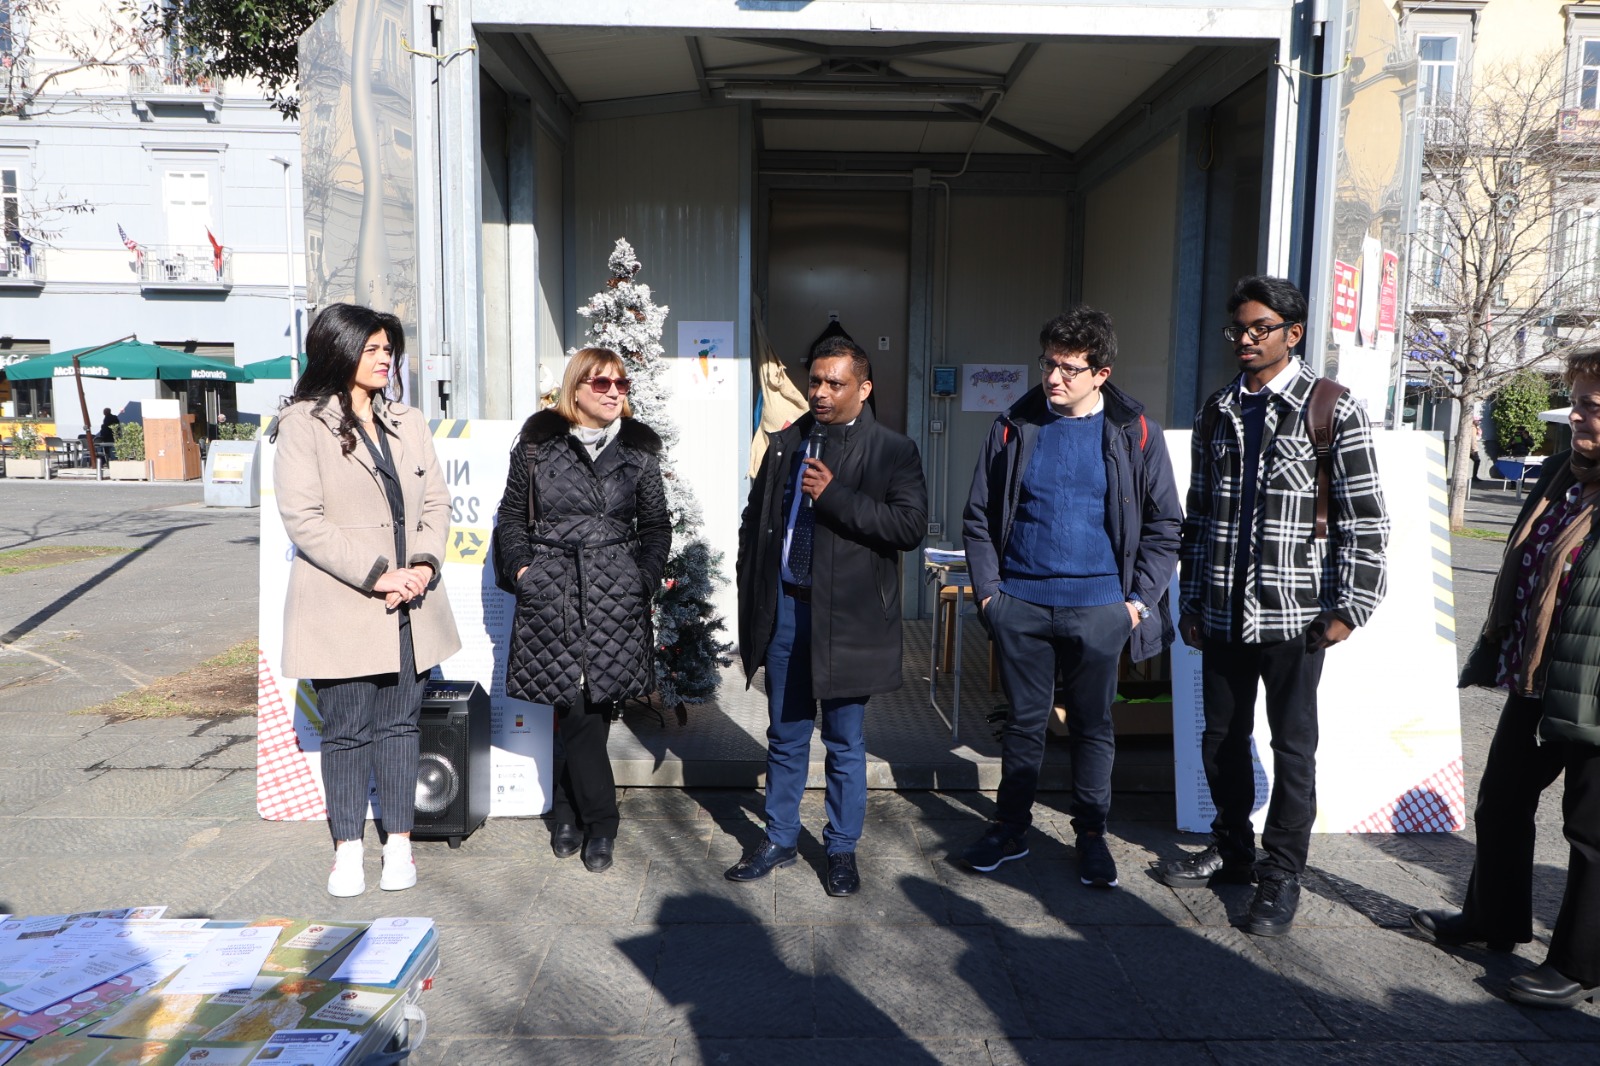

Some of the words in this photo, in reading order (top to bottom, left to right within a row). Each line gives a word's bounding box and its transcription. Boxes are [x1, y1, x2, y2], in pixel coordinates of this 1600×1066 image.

[54, 366, 109, 376] McDnald's
[191, 369, 227, 380] McDonald's
[452, 496, 480, 524] SS
[316, 1013, 350, 1021] Garibaldi
[322, 1009, 355, 1017] Emanuele
